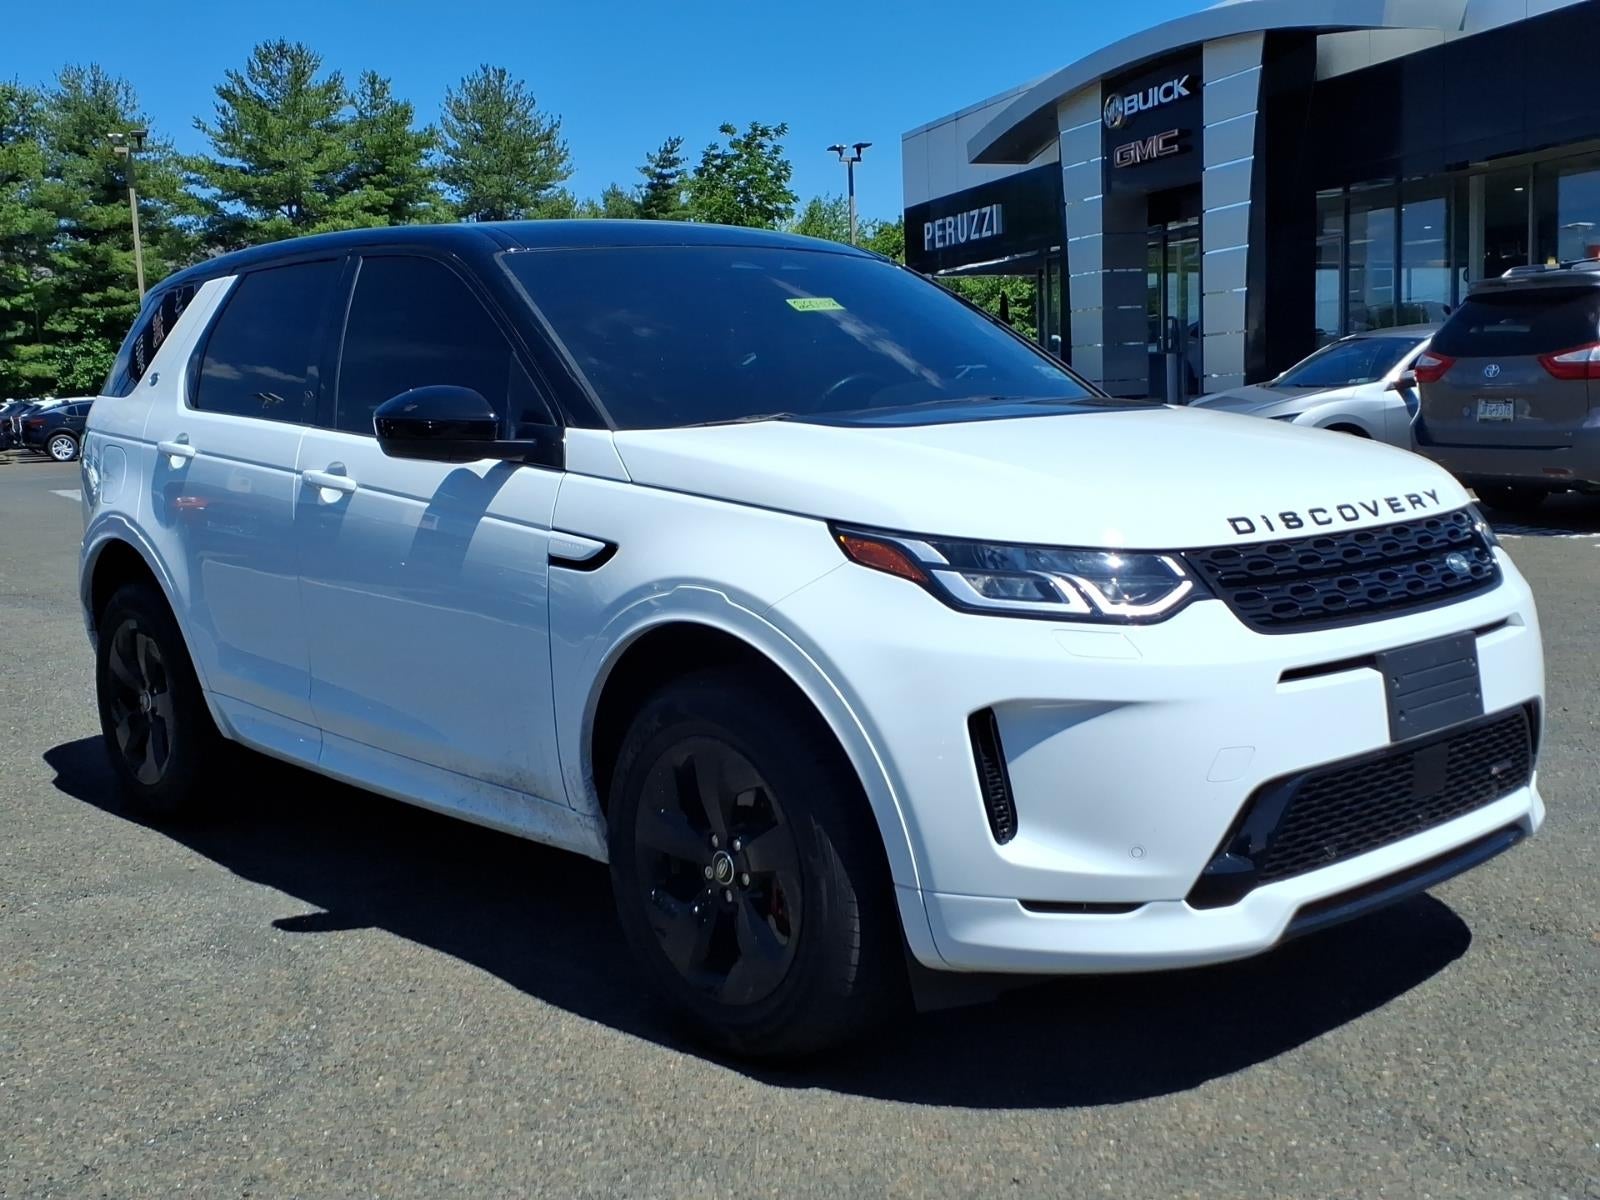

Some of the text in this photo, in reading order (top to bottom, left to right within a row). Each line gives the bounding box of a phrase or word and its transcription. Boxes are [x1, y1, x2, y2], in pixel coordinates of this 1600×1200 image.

[1123, 74, 1191, 116] BUICK
[1114, 128, 1179, 168] GMC
[923, 204, 1001, 252] PERUZZI
[1226, 488, 1440, 535] DISCOVERY
